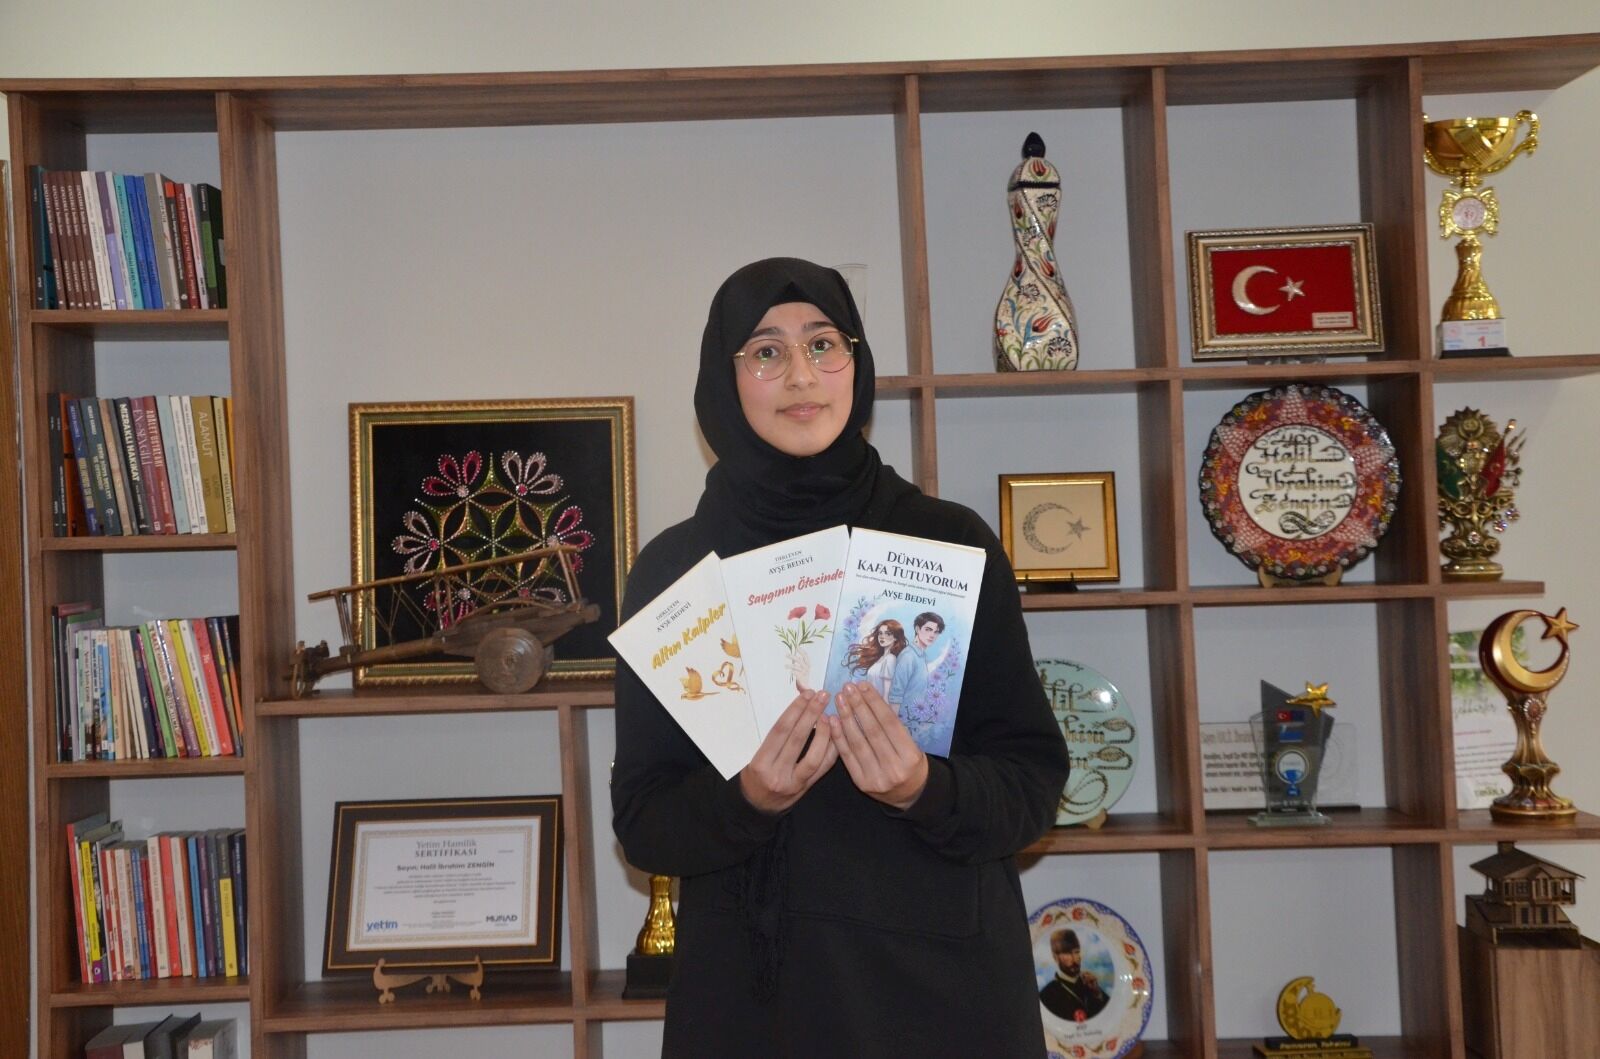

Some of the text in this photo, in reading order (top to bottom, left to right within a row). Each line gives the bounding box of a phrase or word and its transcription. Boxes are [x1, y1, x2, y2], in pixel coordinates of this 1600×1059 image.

[198, 410, 213, 457] ALAMUT
[126, 440, 140, 481] HAKİKAT
[768, 556, 814, 576] AYŞE BEDEVİ
[887, 551, 943, 573] DÜNYAYA
[857, 559, 888, 576] KAFA
[892, 565, 968, 592] TUTUYORUM
[748, 585, 796, 607] Saygının
[881, 588, 936, 607] AYŞE BEDEVİ
[656, 618, 672, 633] AYŞE
[682, 603, 726, 646] Kalpler
[366, 919, 399, 933] yetim
